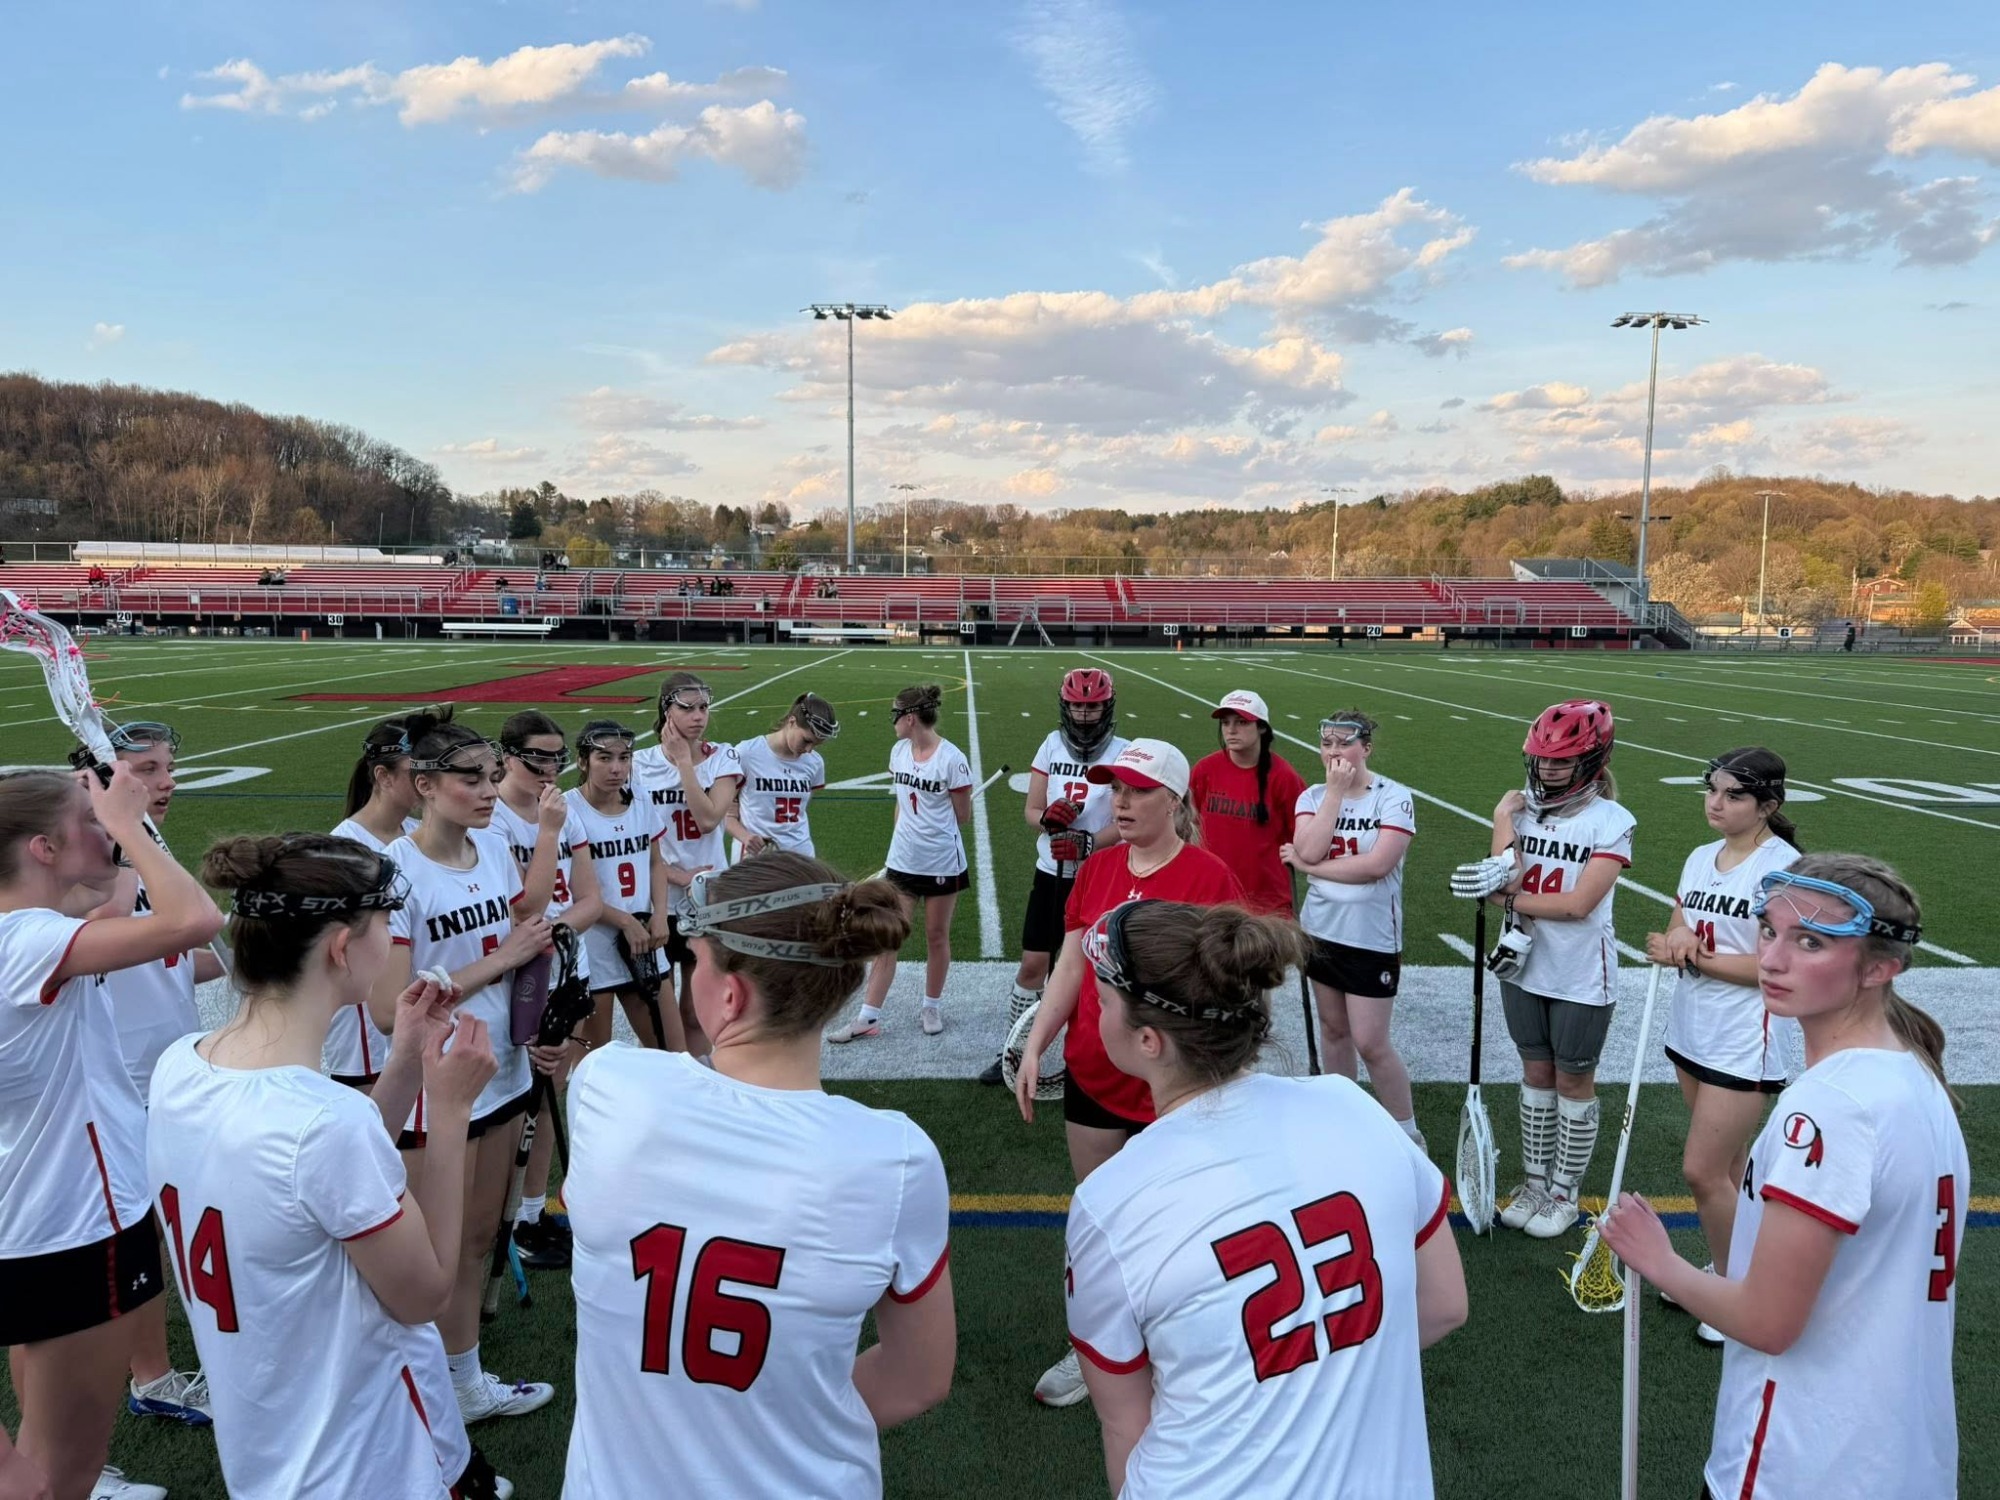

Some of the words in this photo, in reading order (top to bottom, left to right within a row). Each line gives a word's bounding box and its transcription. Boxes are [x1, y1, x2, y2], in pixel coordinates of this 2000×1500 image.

[117, 612, 132, 621] 20
[329, 614, 342, 624] 30
[961, 623, 974, 632] 40
[1164, 624, 1178, 634] 30
[1367, 626, 1381, 635] 20
[1573, 627, 1586, 636] 10
[1780, 628, 1789, 637] G
[895, 771, 941, 792] INDIANA
[1049, 762, 1088, 778] INDIA
[755, 777, 811, 793] INDIAN
[1063, 781, 1088, 803] 12
[775, 797, 802, 823] 25
[909, 791, 918, 815] 1
[671, 809, 701, 841] 16
[588, 833, 650, 860] NDIANA
[1329, 836, 1358, 860] 21
[1519, 834, 1591, 864] NDIANA
[617, 862, 635, 898] 9
[1521, 864, 1564, 895] 44
[300, 896, 348, 910] STX
[728, 897, 772, 917] STX
[773, 892, 800, 904] PLUS
[426, 895, 509, 942] INDIAN
[766, 942, 813, 960] STX
[1143, 991, 1188, 1016] STX
[519, 1112, 540, 1152] STX
[159, 1182, 240, 1333] 14
[1210, 1190, 1384, 1384] 23
[630, 1221, 786, 1393] 16
